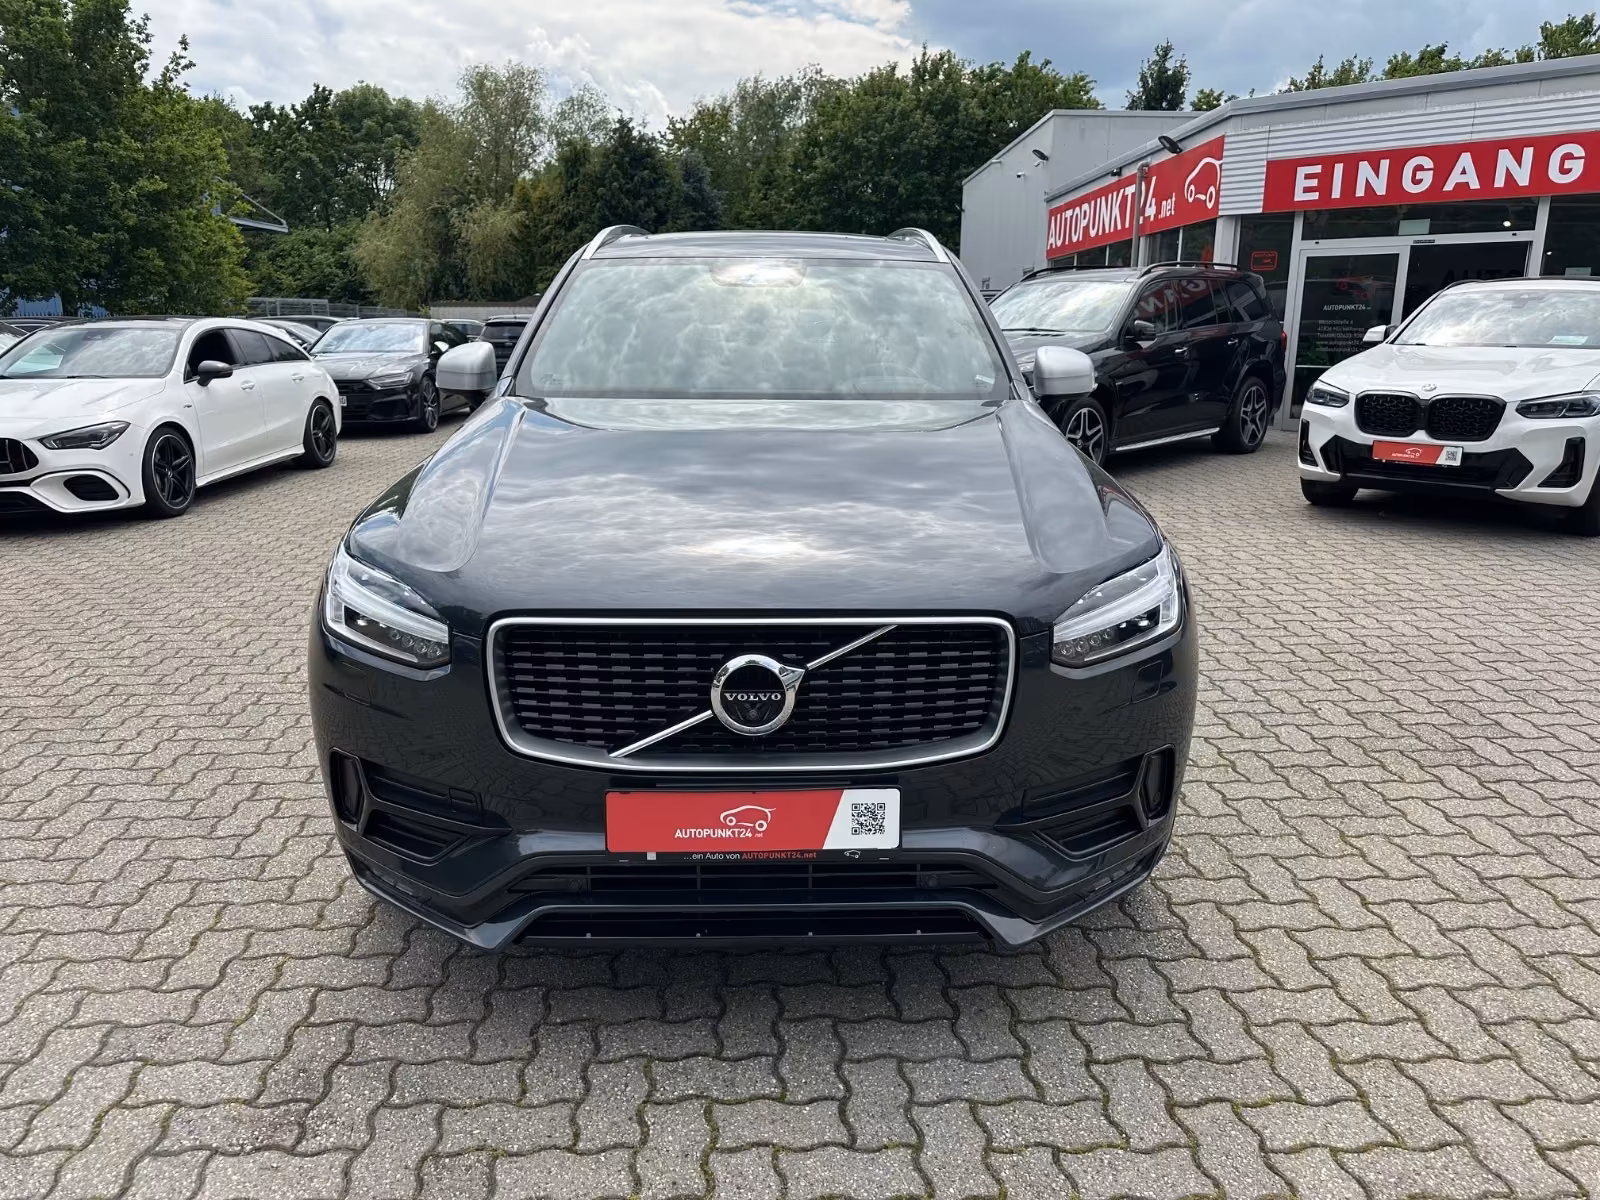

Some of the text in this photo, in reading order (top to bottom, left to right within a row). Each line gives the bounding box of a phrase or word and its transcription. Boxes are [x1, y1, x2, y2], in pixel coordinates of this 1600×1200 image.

[1293, 143, 1586, 202] EINGANG
[1158, 192, 1176, 219] .net
[724, 692, 781, 701] VOLVO
[674, 828, 752, 839] AUTOPUNKT24
[705, 852, 724, 860] Auto
[741, 851, 817, 860] AUTOPUNKT24.net
